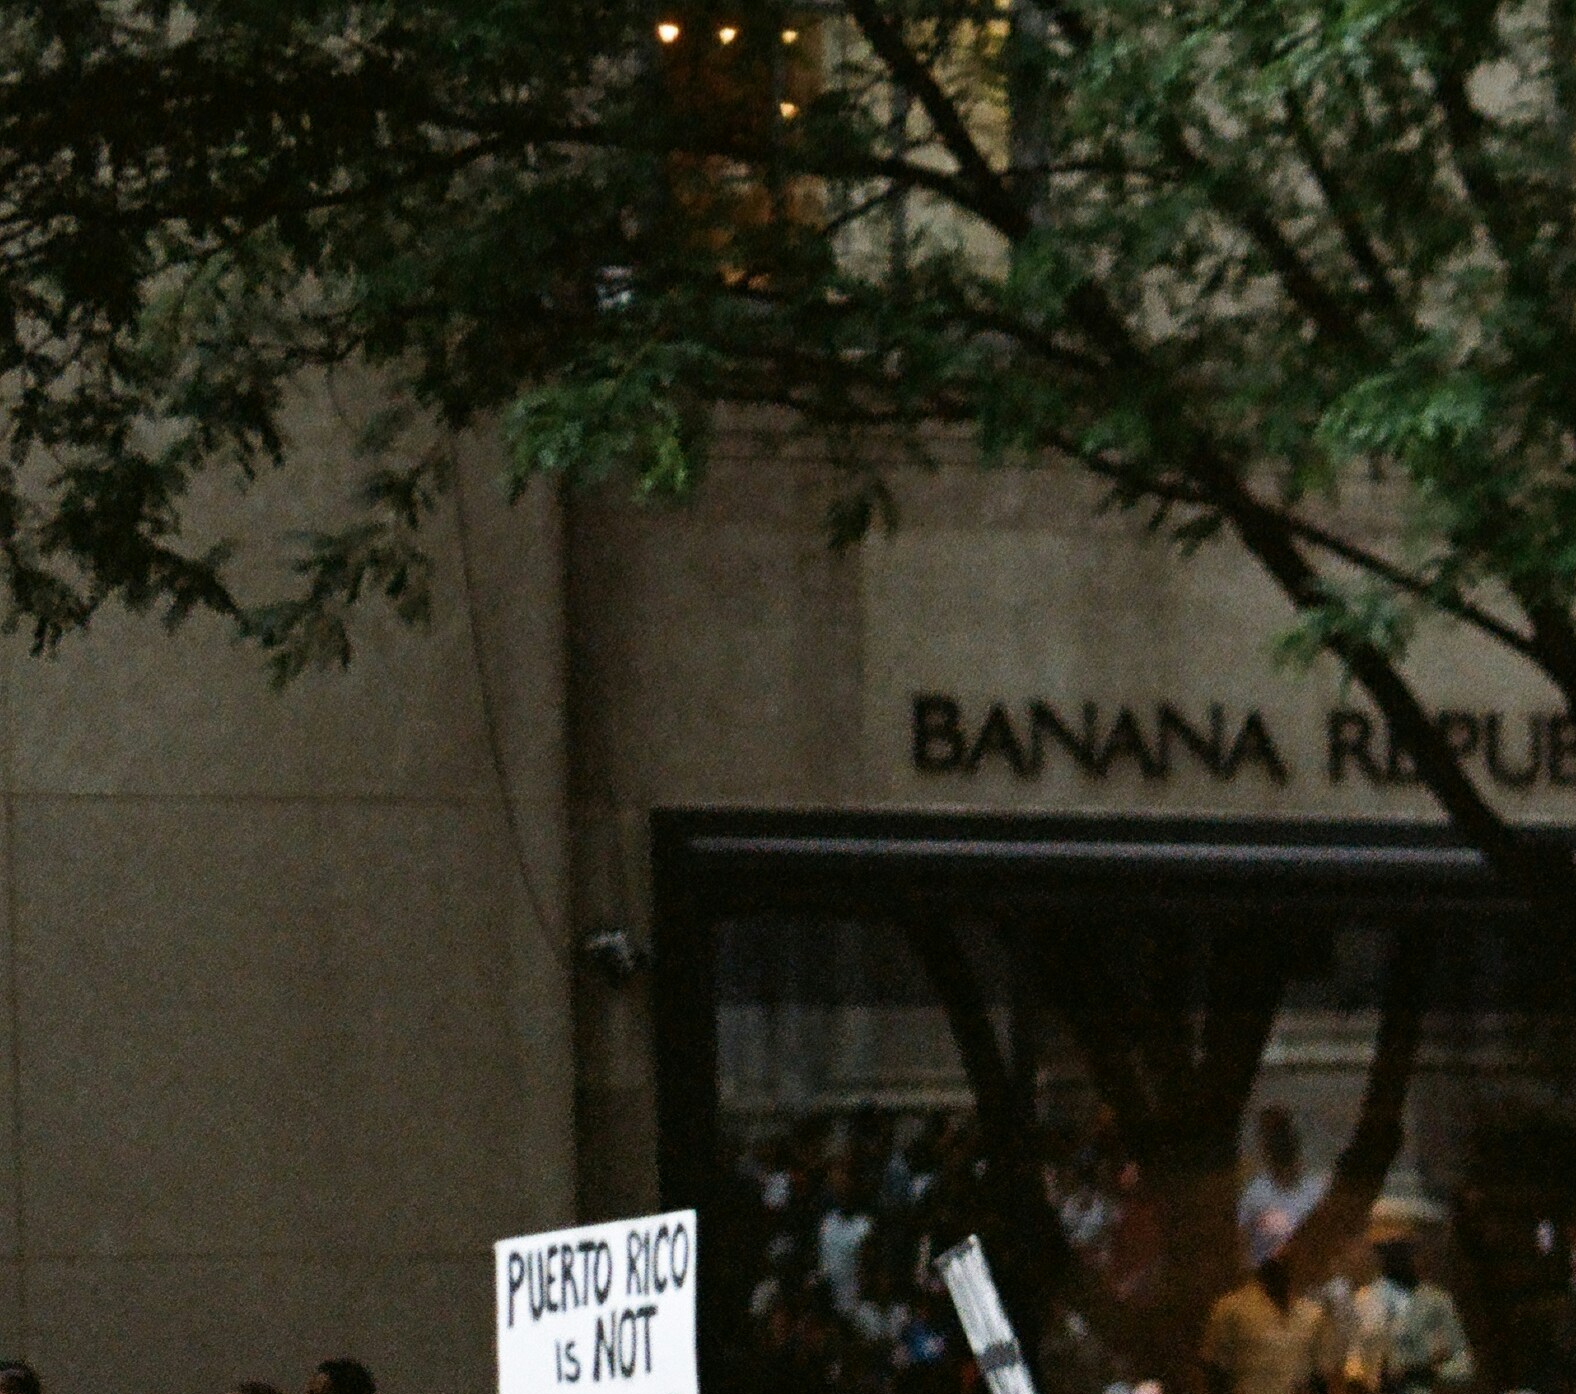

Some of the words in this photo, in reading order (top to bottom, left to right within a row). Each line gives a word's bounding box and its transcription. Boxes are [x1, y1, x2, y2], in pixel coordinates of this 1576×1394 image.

[911, 692, 1289, 783] BANANA
[508, 1239, 613, 1329] PUERTO
[626, 1222, 690, 1295] RICO
[556, 1338, 581, 1384] IS
[593, 1305, 658, 1382] NOT
